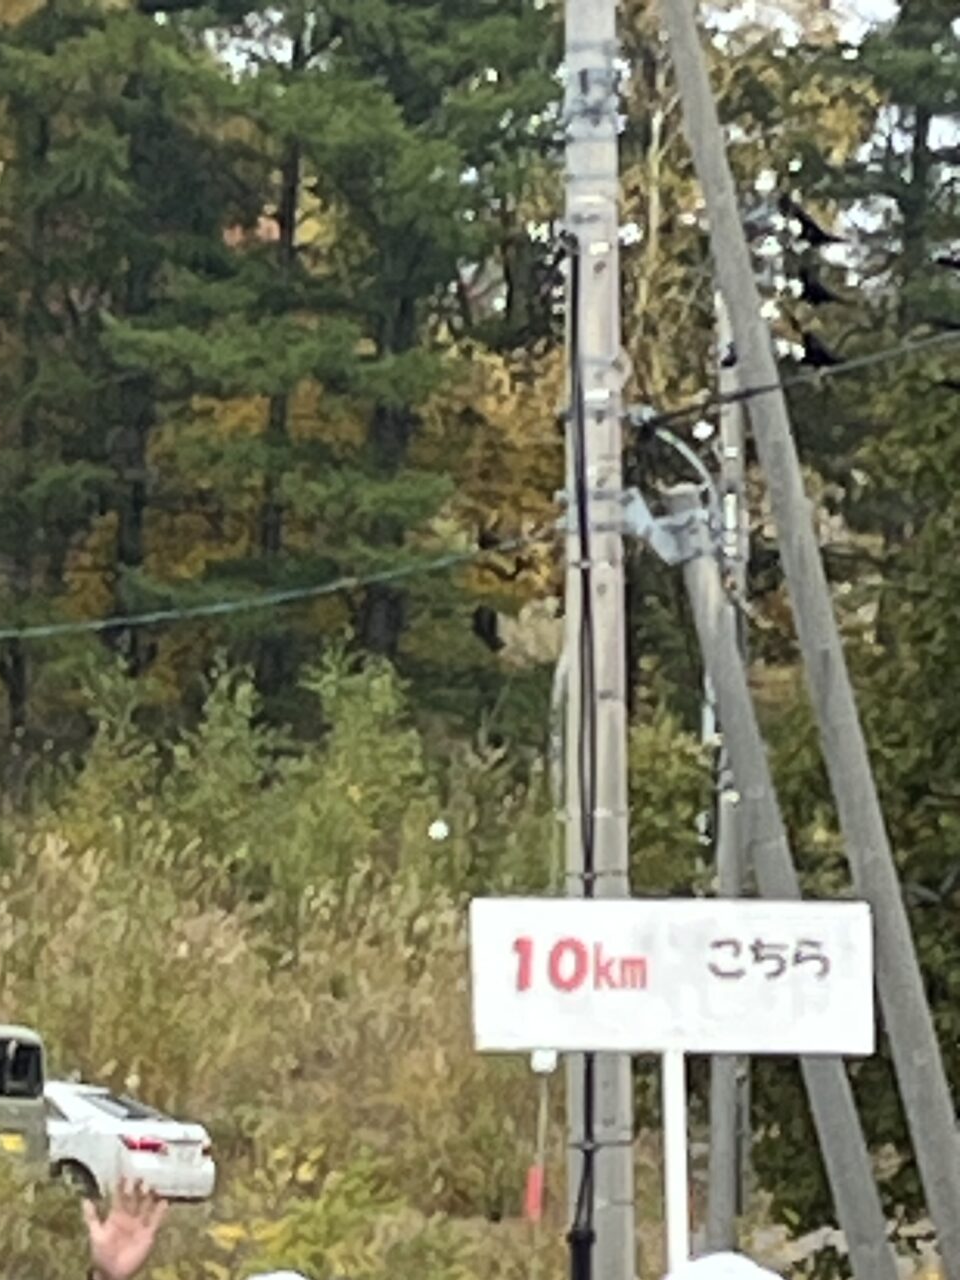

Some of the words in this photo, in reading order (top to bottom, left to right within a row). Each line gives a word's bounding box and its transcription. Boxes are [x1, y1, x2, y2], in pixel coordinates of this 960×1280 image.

[512, 936, 648, 992] 10km
[708, 938, 831, 979] こちら
